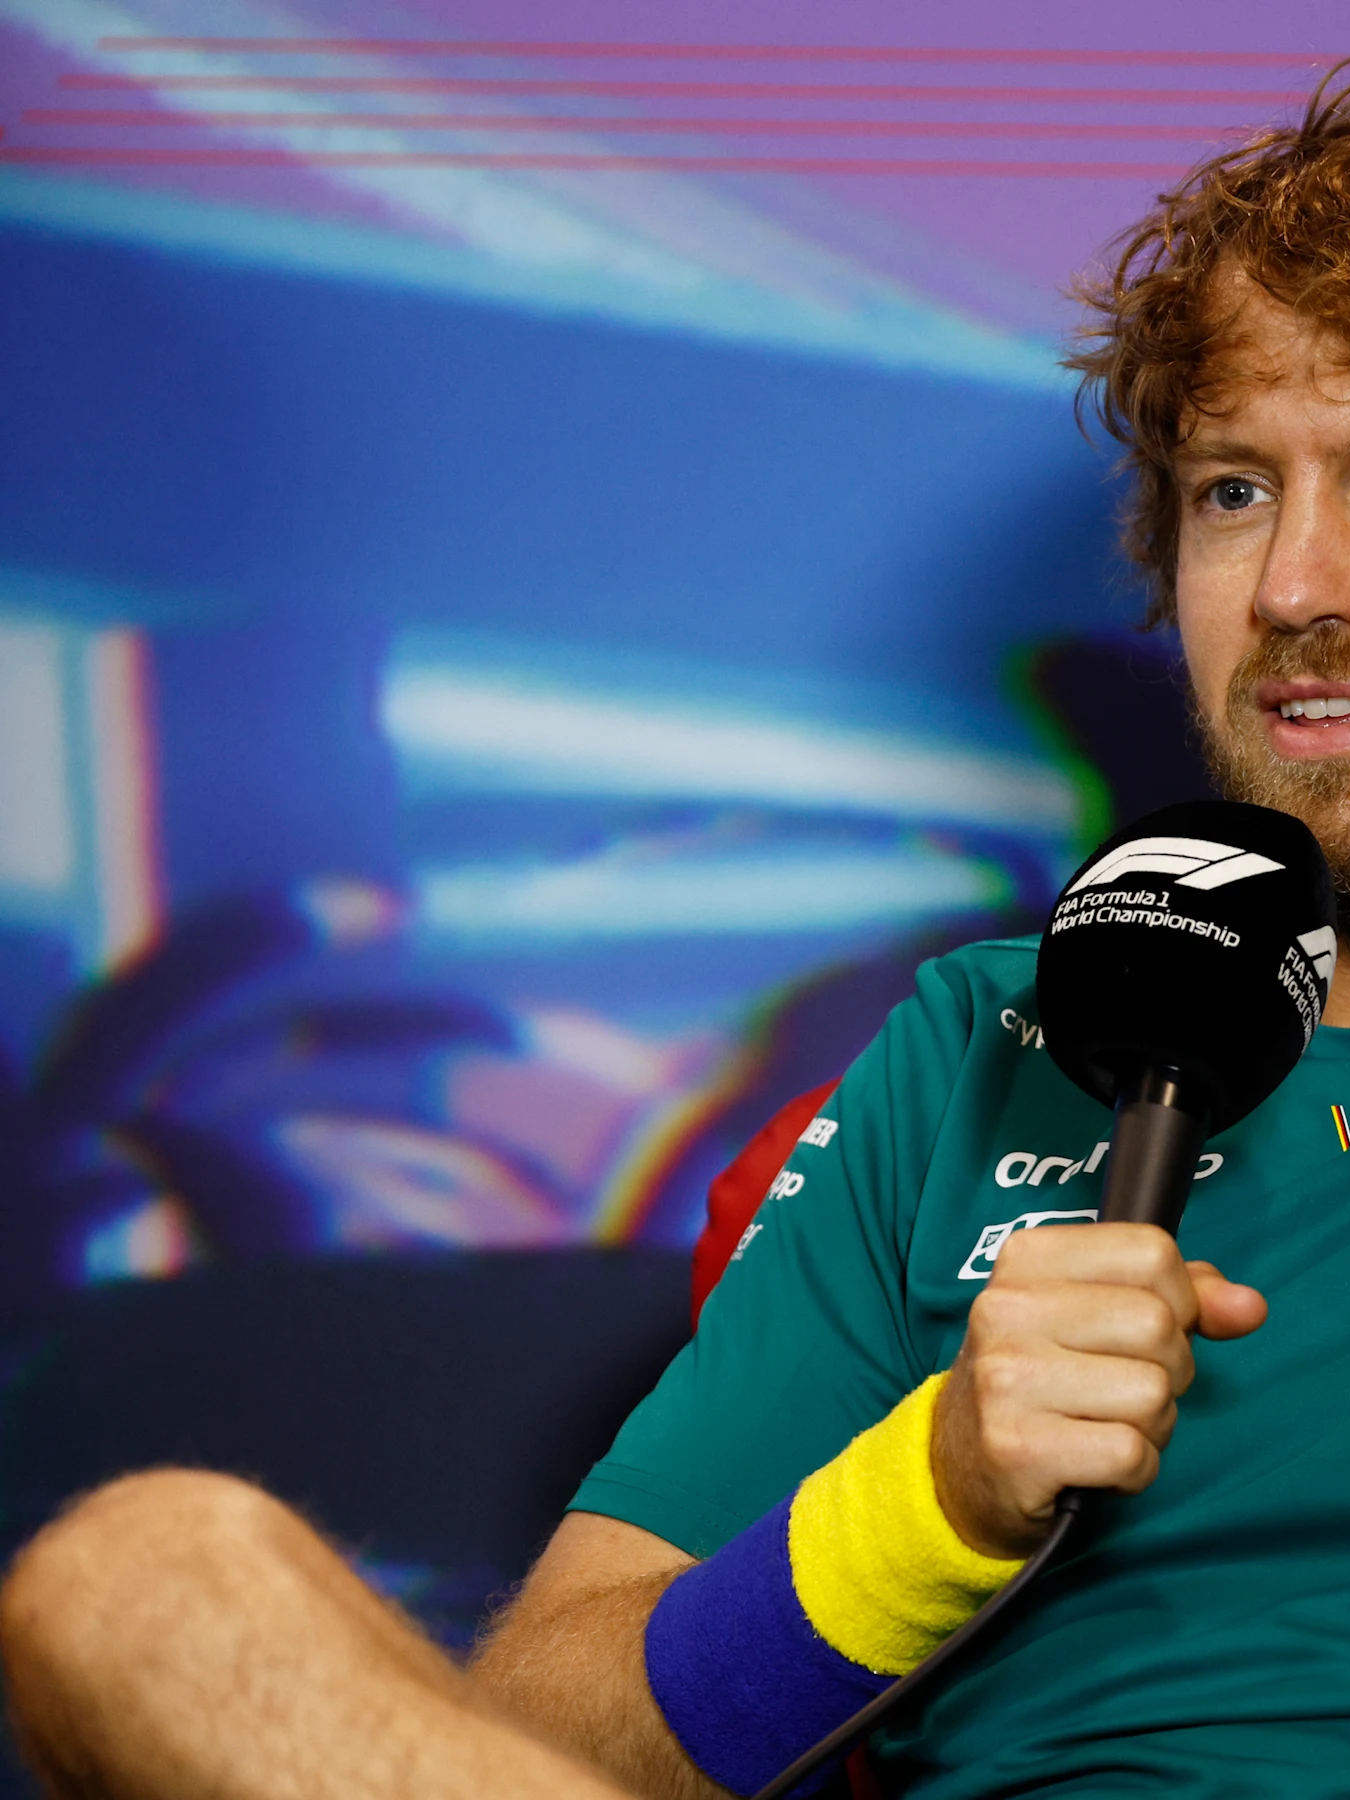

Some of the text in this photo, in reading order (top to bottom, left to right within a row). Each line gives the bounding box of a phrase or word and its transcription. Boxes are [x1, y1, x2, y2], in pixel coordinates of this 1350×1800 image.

[1055, 890, 1170, 918] FIA Formula 1
[1051, 907, 1241, 947] World Championship
[1285, 946, 1305, 980] FIA
